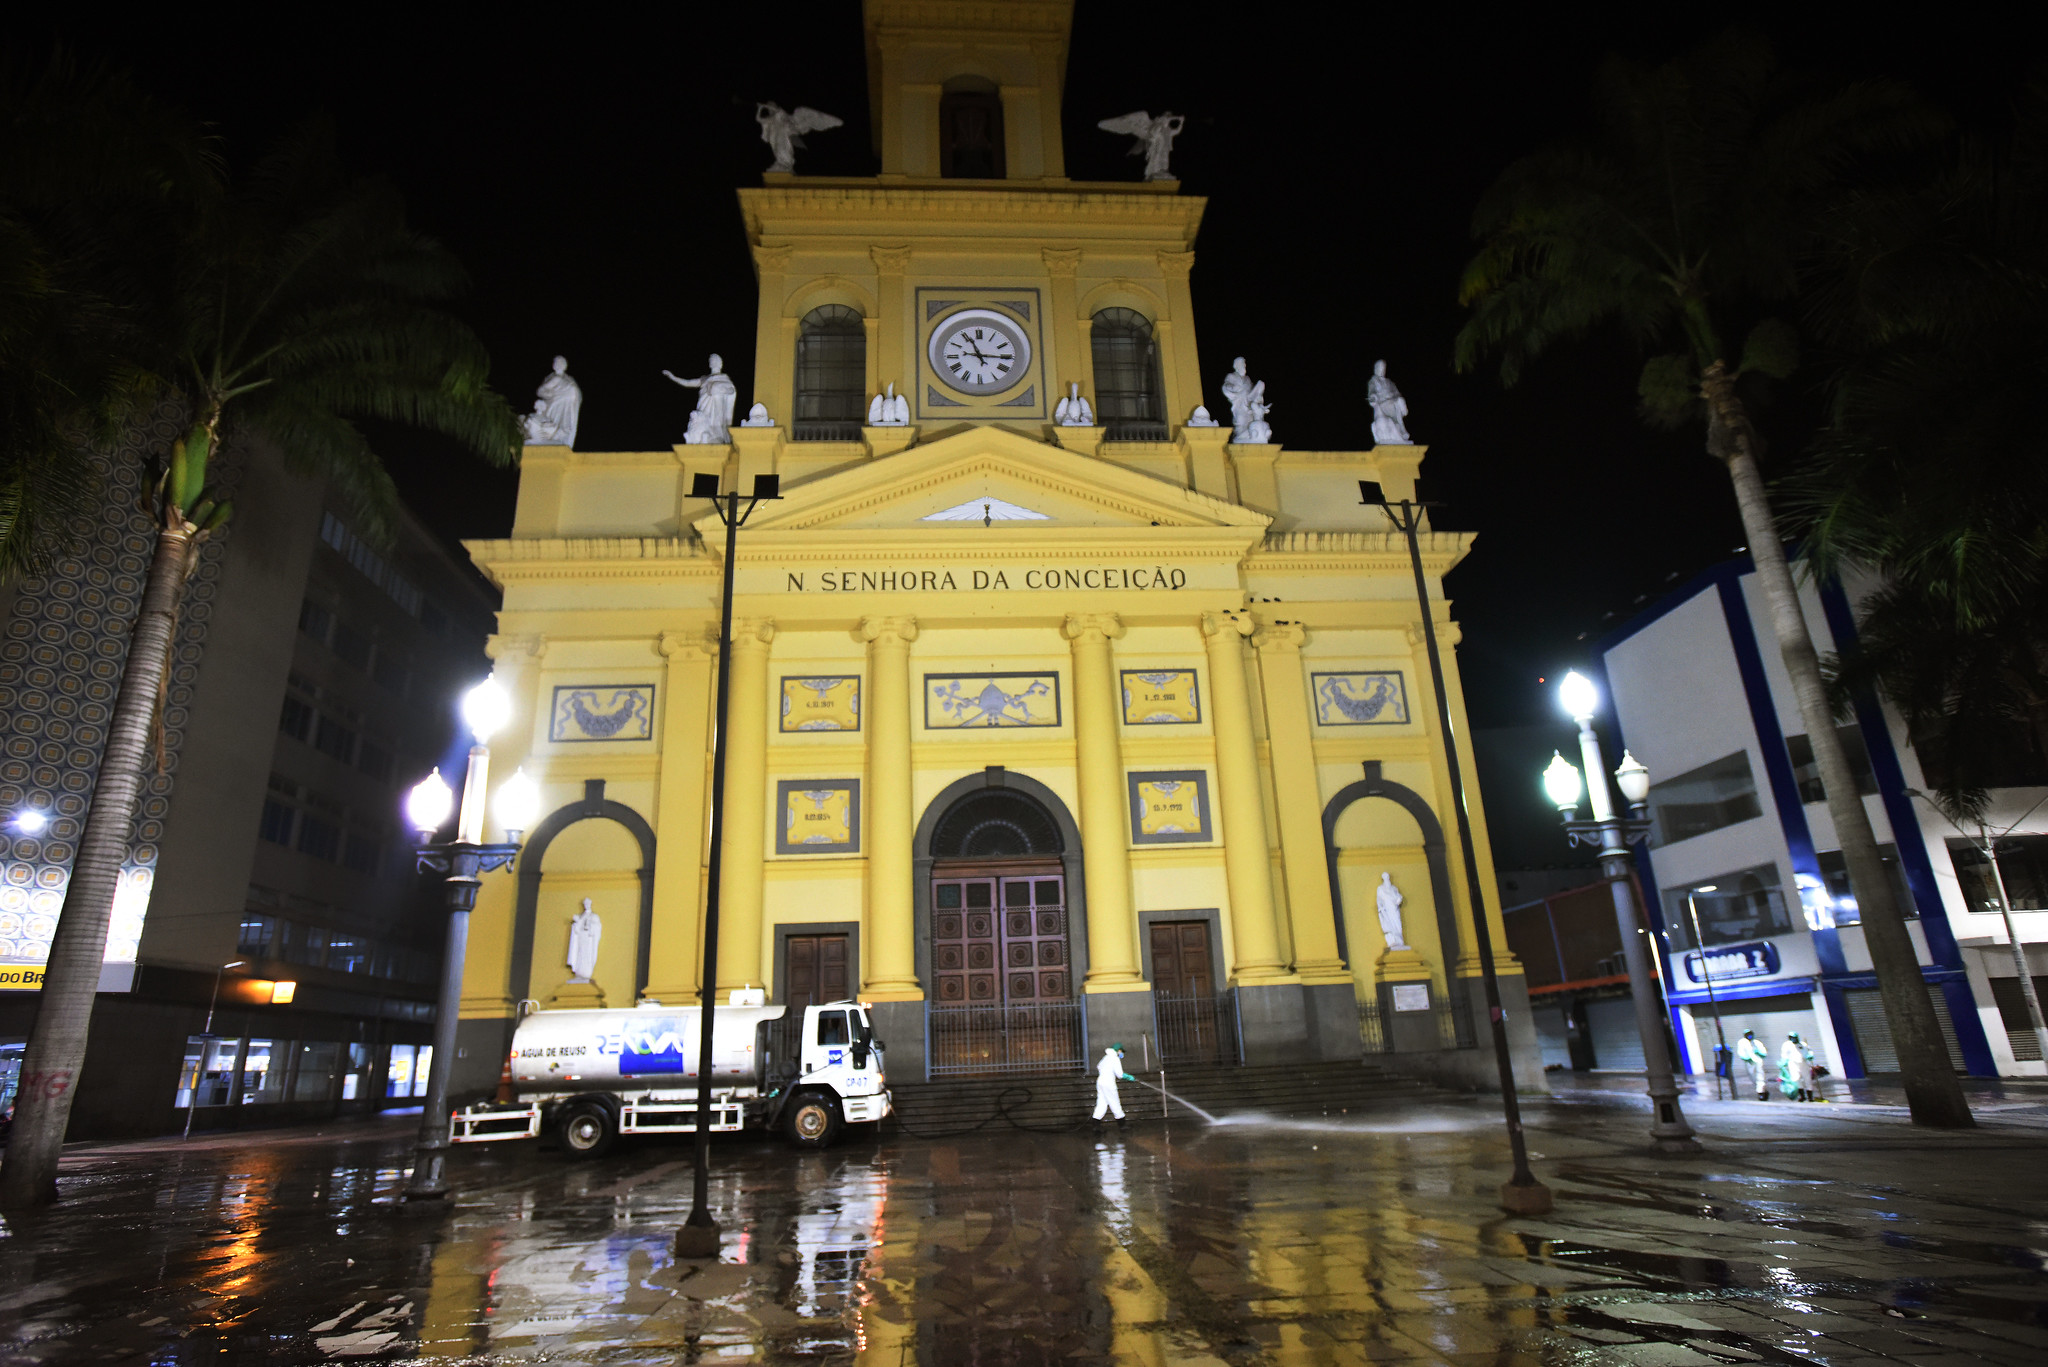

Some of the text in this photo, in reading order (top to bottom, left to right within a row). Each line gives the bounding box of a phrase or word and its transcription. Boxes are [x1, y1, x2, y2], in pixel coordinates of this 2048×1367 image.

[787, 565, 1187, 592] N. SENHORA DA CONCEIÇÃO
[546, 1047, 557, 1057] DE
[558, 1045, 587, 1057] REUSO
